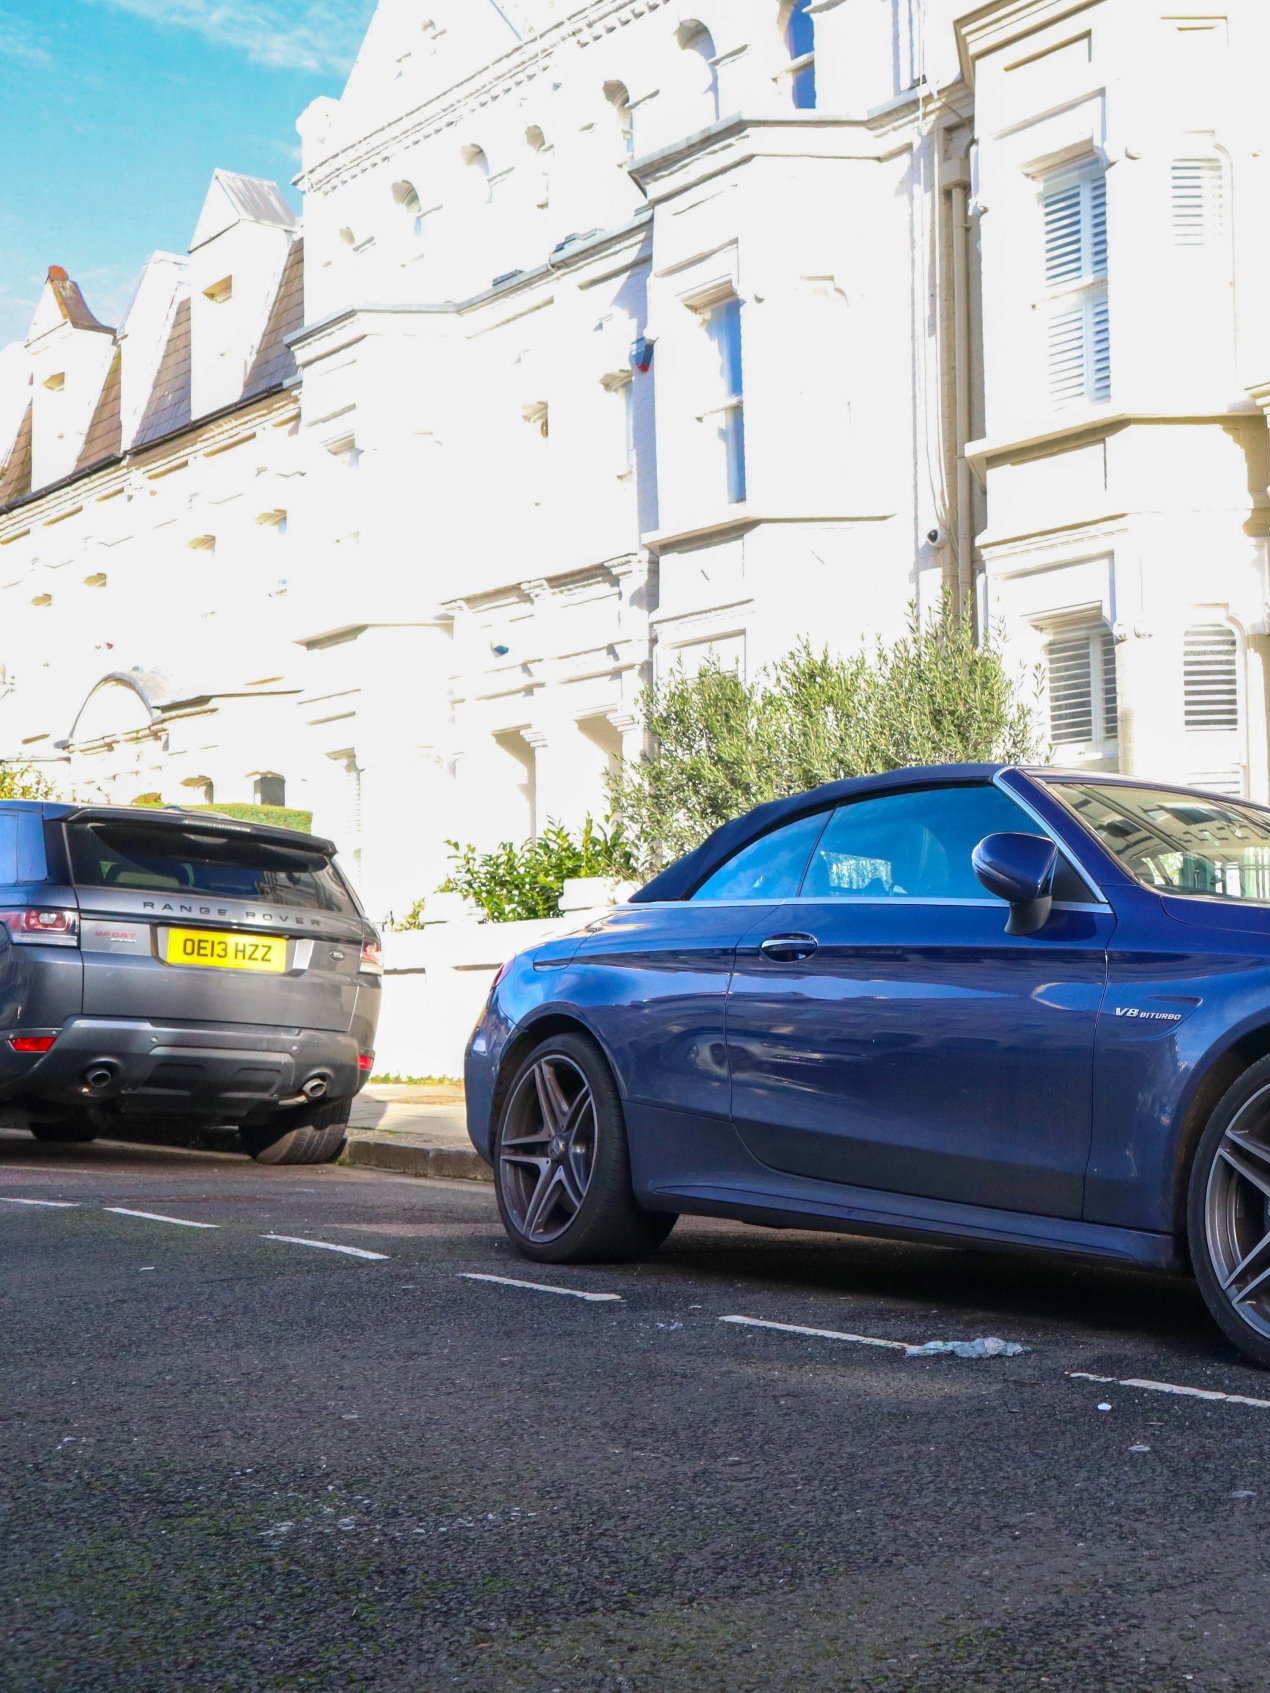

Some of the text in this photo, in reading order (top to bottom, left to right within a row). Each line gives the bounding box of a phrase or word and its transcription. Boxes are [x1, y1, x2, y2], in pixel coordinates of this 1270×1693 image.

[143, 902, 321, 926] RANGE ROVER
[183, 938, 272, 962] OE13 HZZ
[1116, 1007, 1182, 1020] V8 BITURBO
